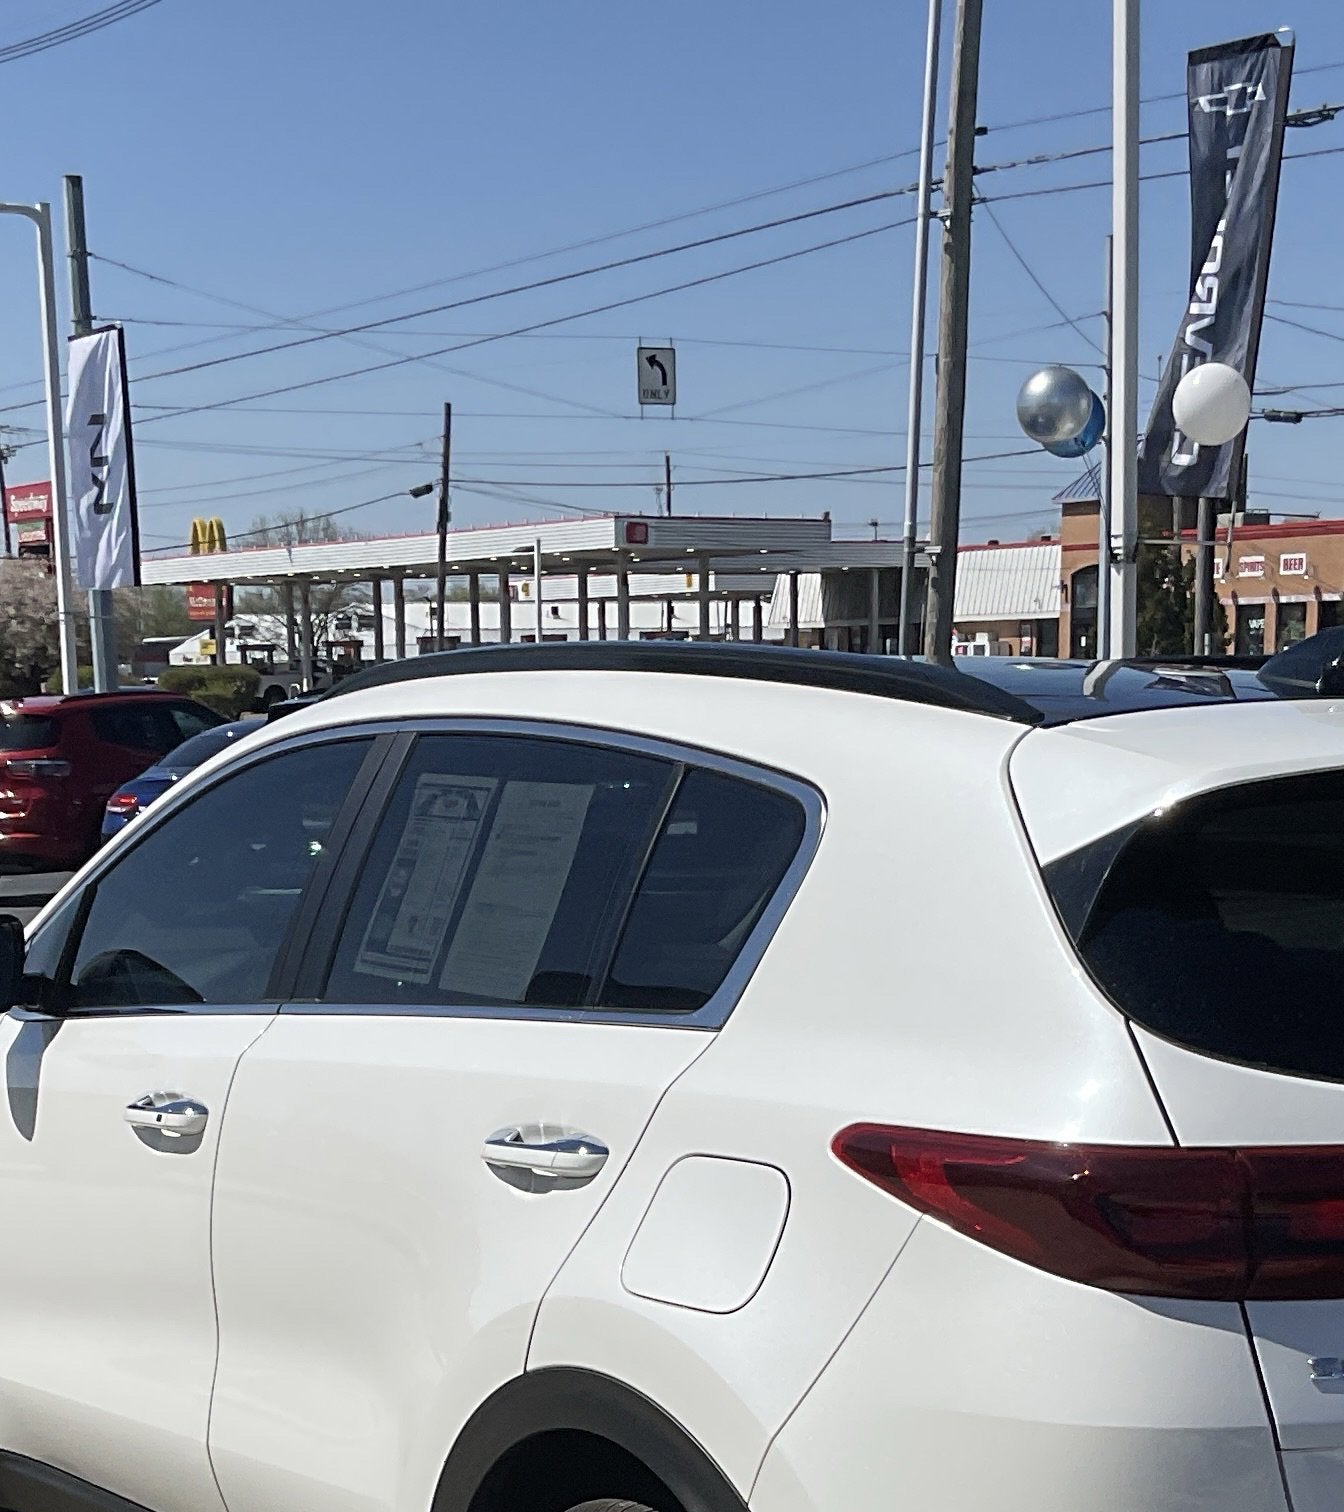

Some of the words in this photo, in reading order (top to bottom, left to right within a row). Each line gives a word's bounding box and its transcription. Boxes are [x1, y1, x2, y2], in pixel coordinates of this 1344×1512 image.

[642, 389, 671, 400] ONLY
[9, 492, 49, 517] Speedway
[1283, 557, 1304, 571] BEER
